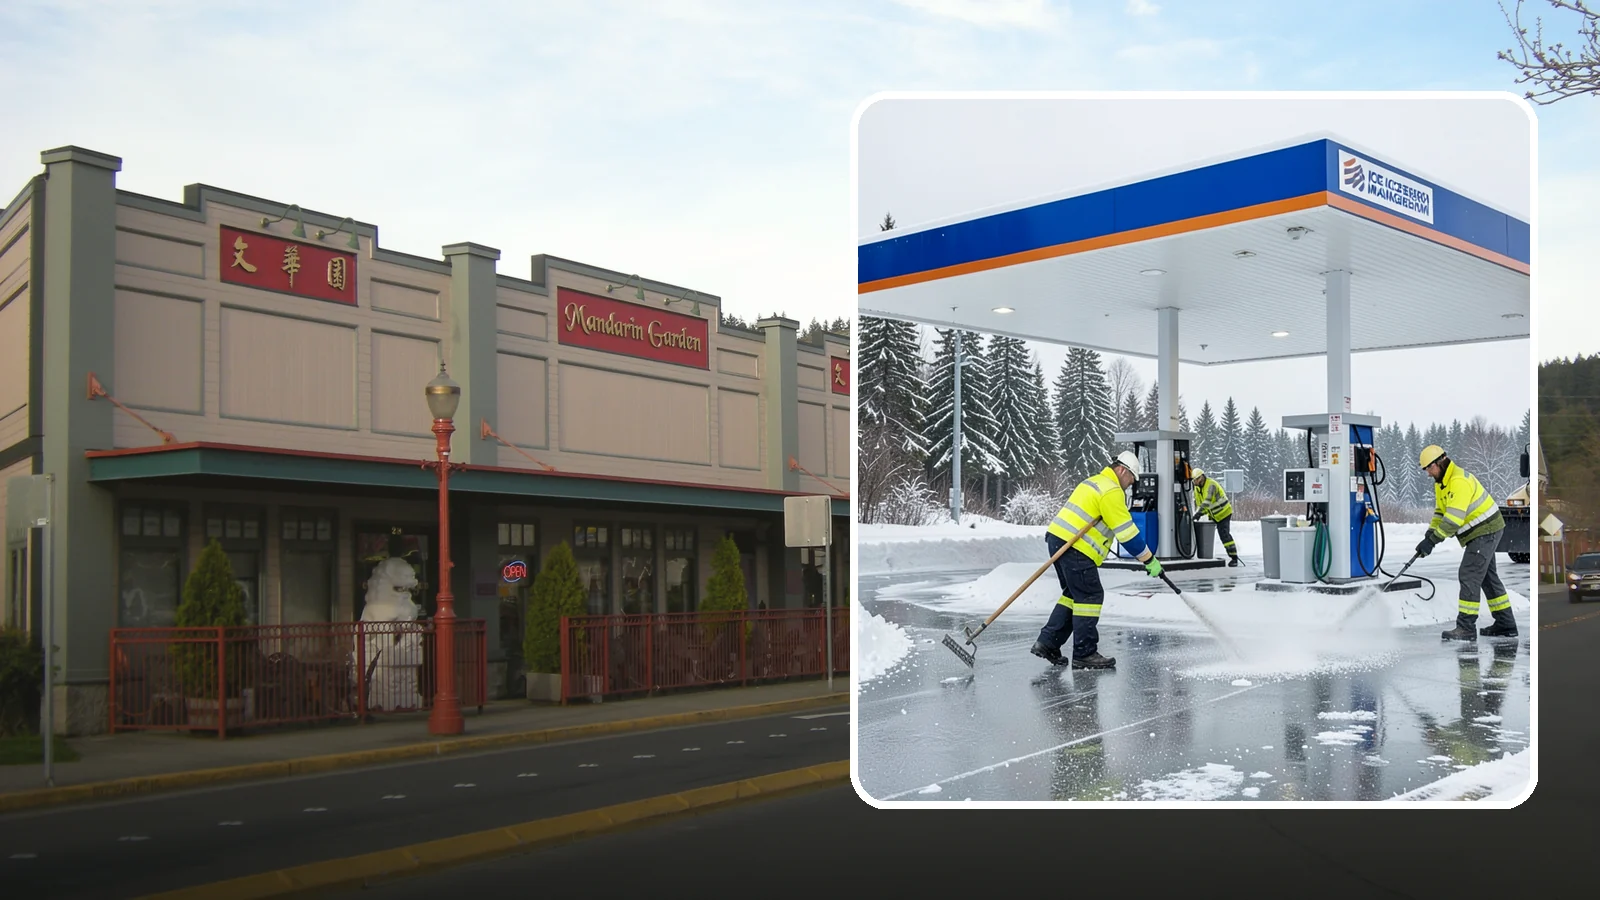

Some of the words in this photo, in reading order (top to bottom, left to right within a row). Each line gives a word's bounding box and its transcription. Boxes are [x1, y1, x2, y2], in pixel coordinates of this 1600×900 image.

[231, 235, 346, 290] 文華園
[564, 302, 644, 341] Mandarin
[648, 320, 701, 352] Garden
[503, 565, 526, 578] OPEN
